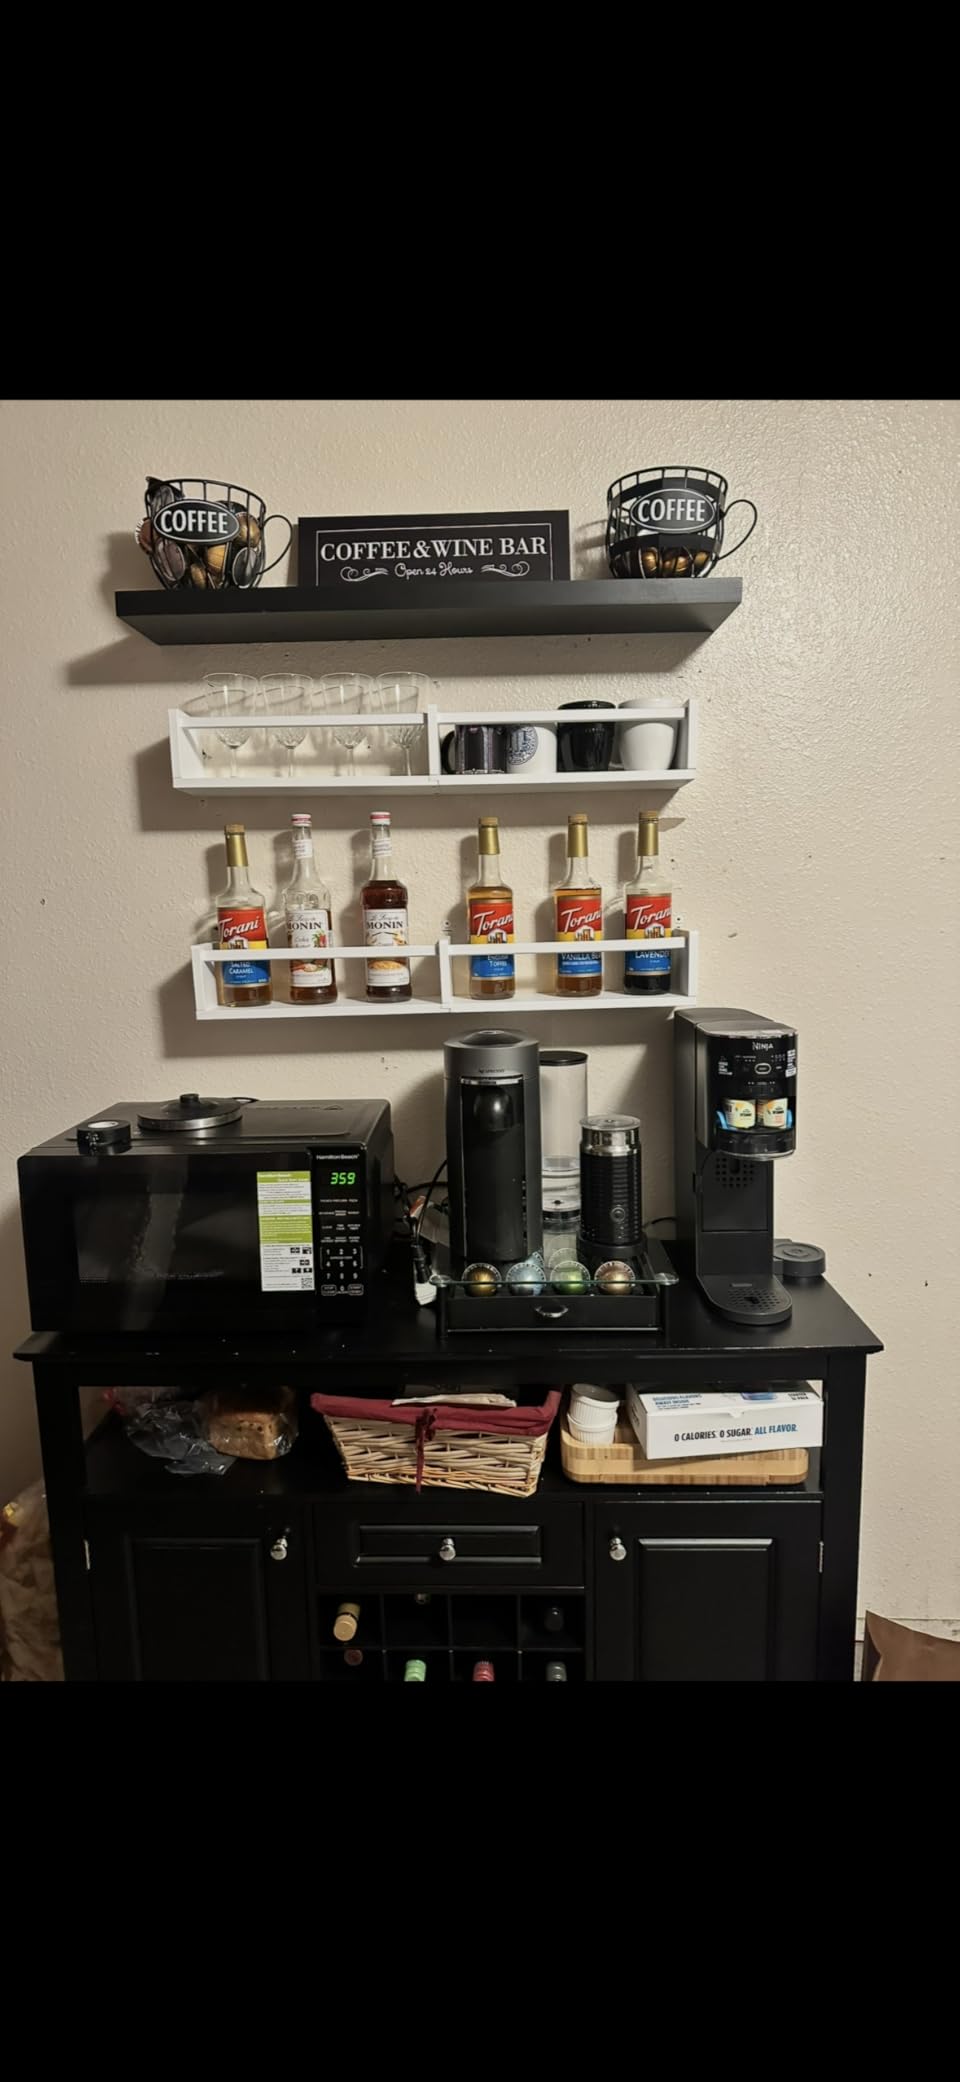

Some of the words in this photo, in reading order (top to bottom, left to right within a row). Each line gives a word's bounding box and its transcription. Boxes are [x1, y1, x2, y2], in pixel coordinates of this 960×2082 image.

[638, 498, 706, 522] COFFEE
[160, 509, 229, 534] COFFEE
[499, 536, 548, 555] BAR
[394, 562, 425, 581] Open
[425, 567, 437, 576] 24
[439, 561, 474, 577] Hours
[218, 915, 260, 945] Torani
[752, 1041, 774, 1052] NINJA
[674, 1433, 680, 1442] 0
[754, 1426, 767, 1435] ALL
